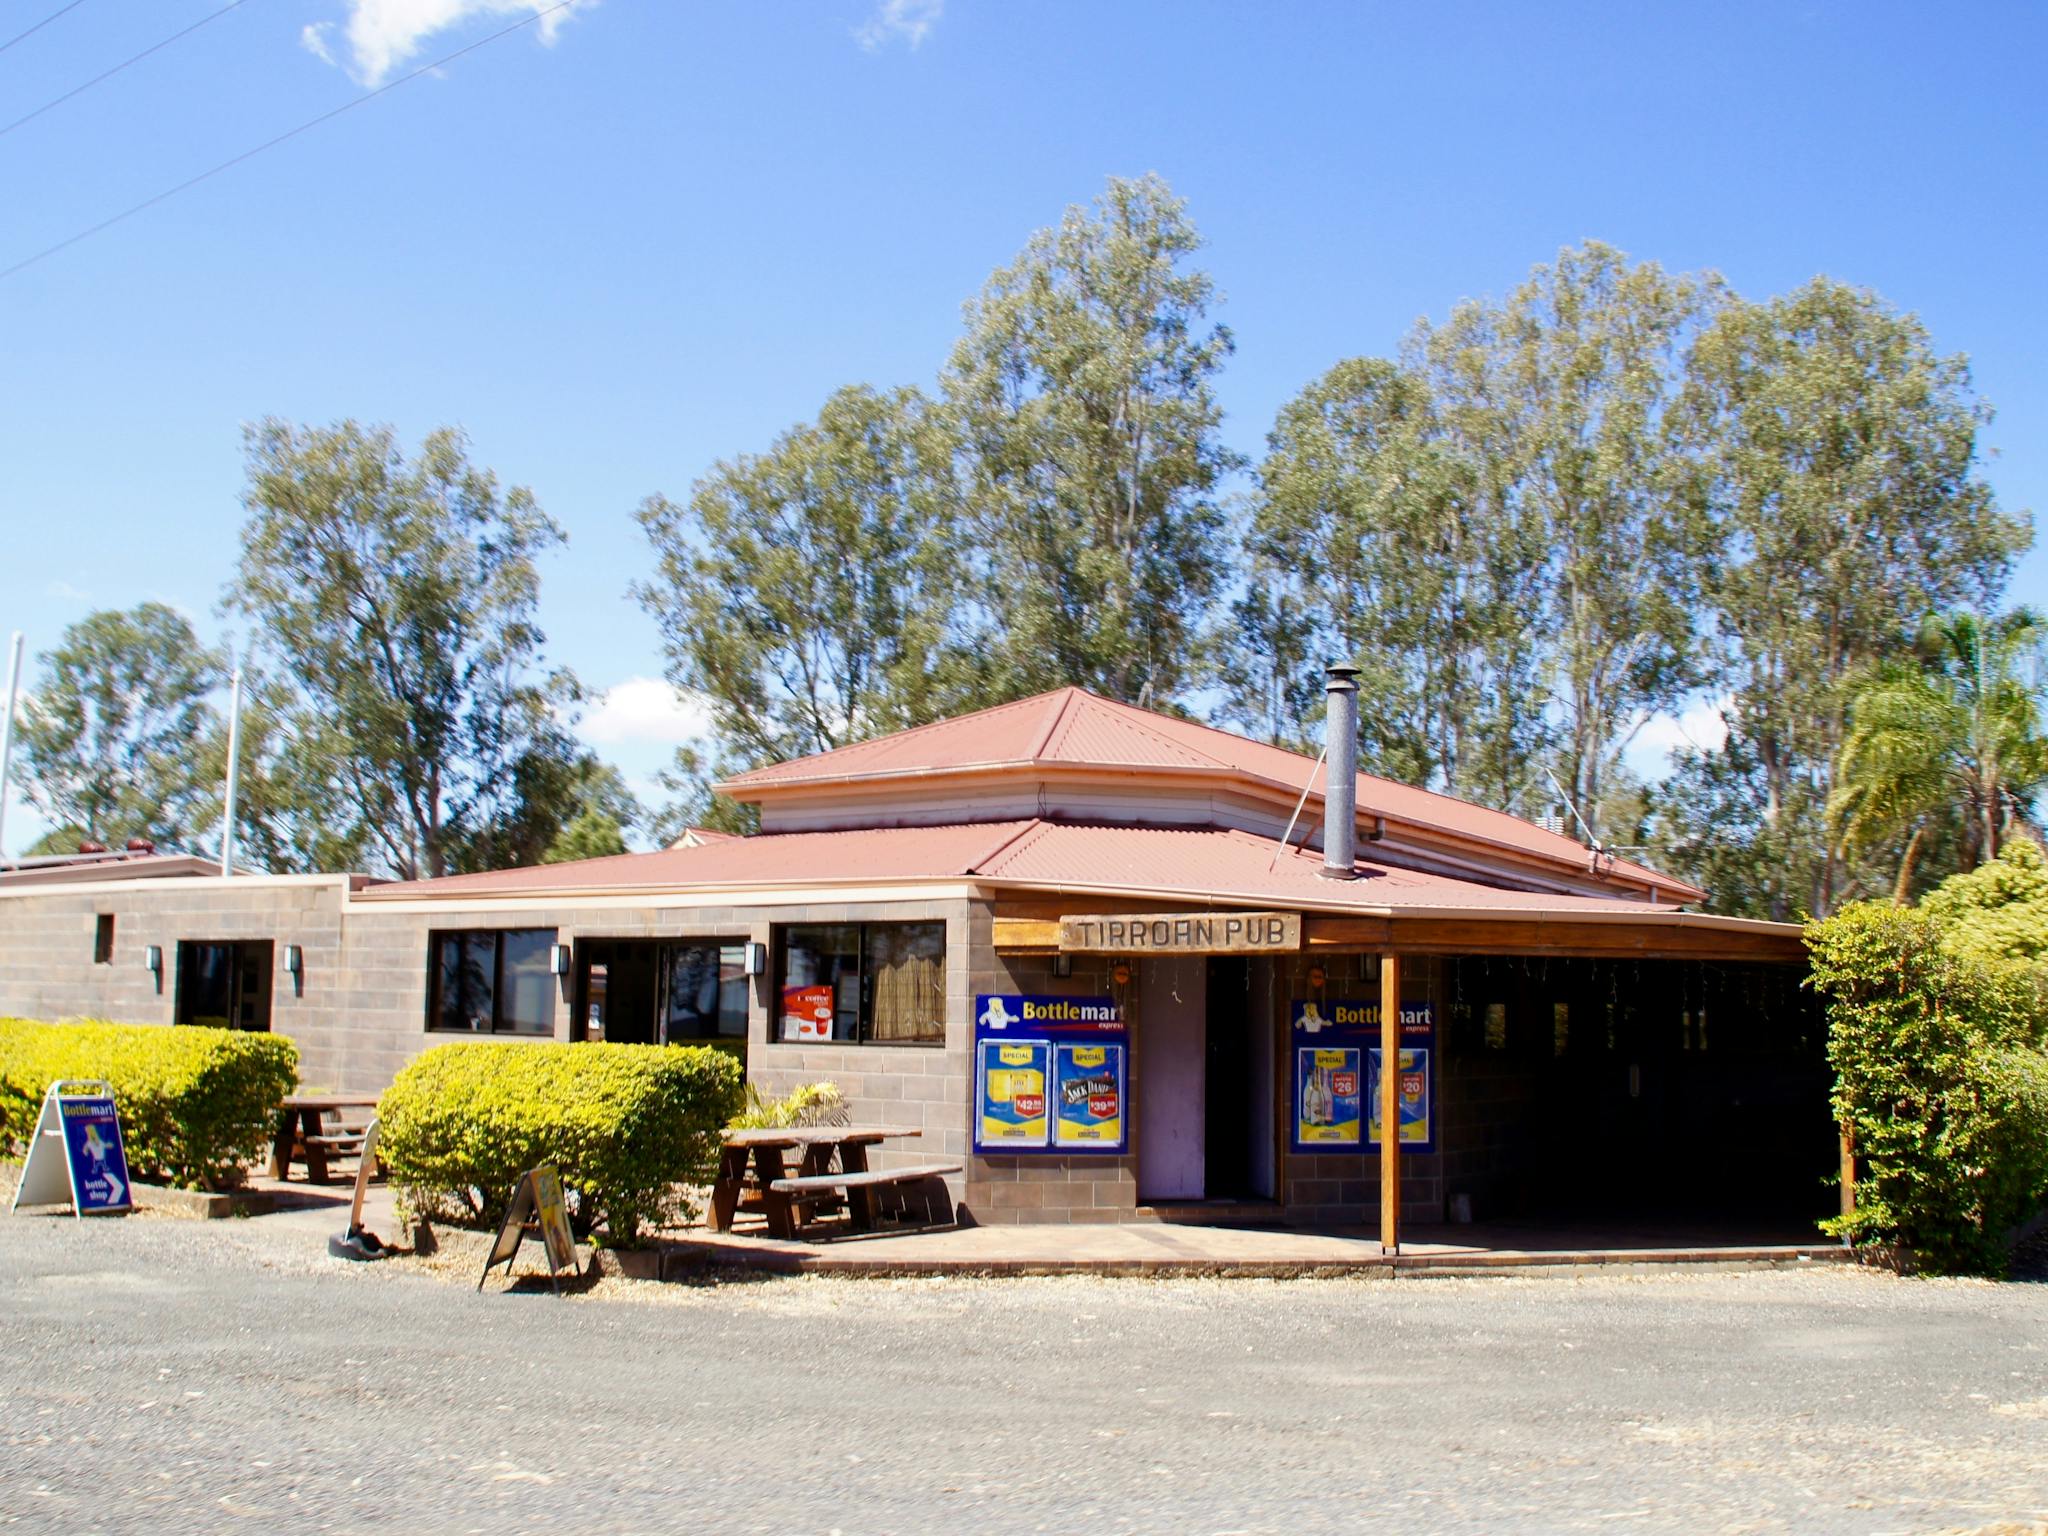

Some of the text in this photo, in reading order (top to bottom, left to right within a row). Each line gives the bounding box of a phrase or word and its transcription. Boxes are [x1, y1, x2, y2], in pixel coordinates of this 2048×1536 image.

[1078, 918, 1285, 947] TIRROAN PUB
[1023, 1001, 1125, 1021] Bottlemart
[1335, 1006, 1432, 1024] Bottlart
[1003, 1052, 1029, 1060] SPECIAL
[1075, 1053, 1102, 1061] SPECIAL
[1318, 1056, 1343, 1064] SPECIAL
[1334, 1082, 1352, 1093] $26
[1403, 1082, 1420, 1093] $20
[1067, 1084, 1088, 1103] JACK
[63, 1103, 113, 1117] Bottlemart
[85, 1180, 107, 1190] bottle
[90, 1190, 108, 1200] shop
